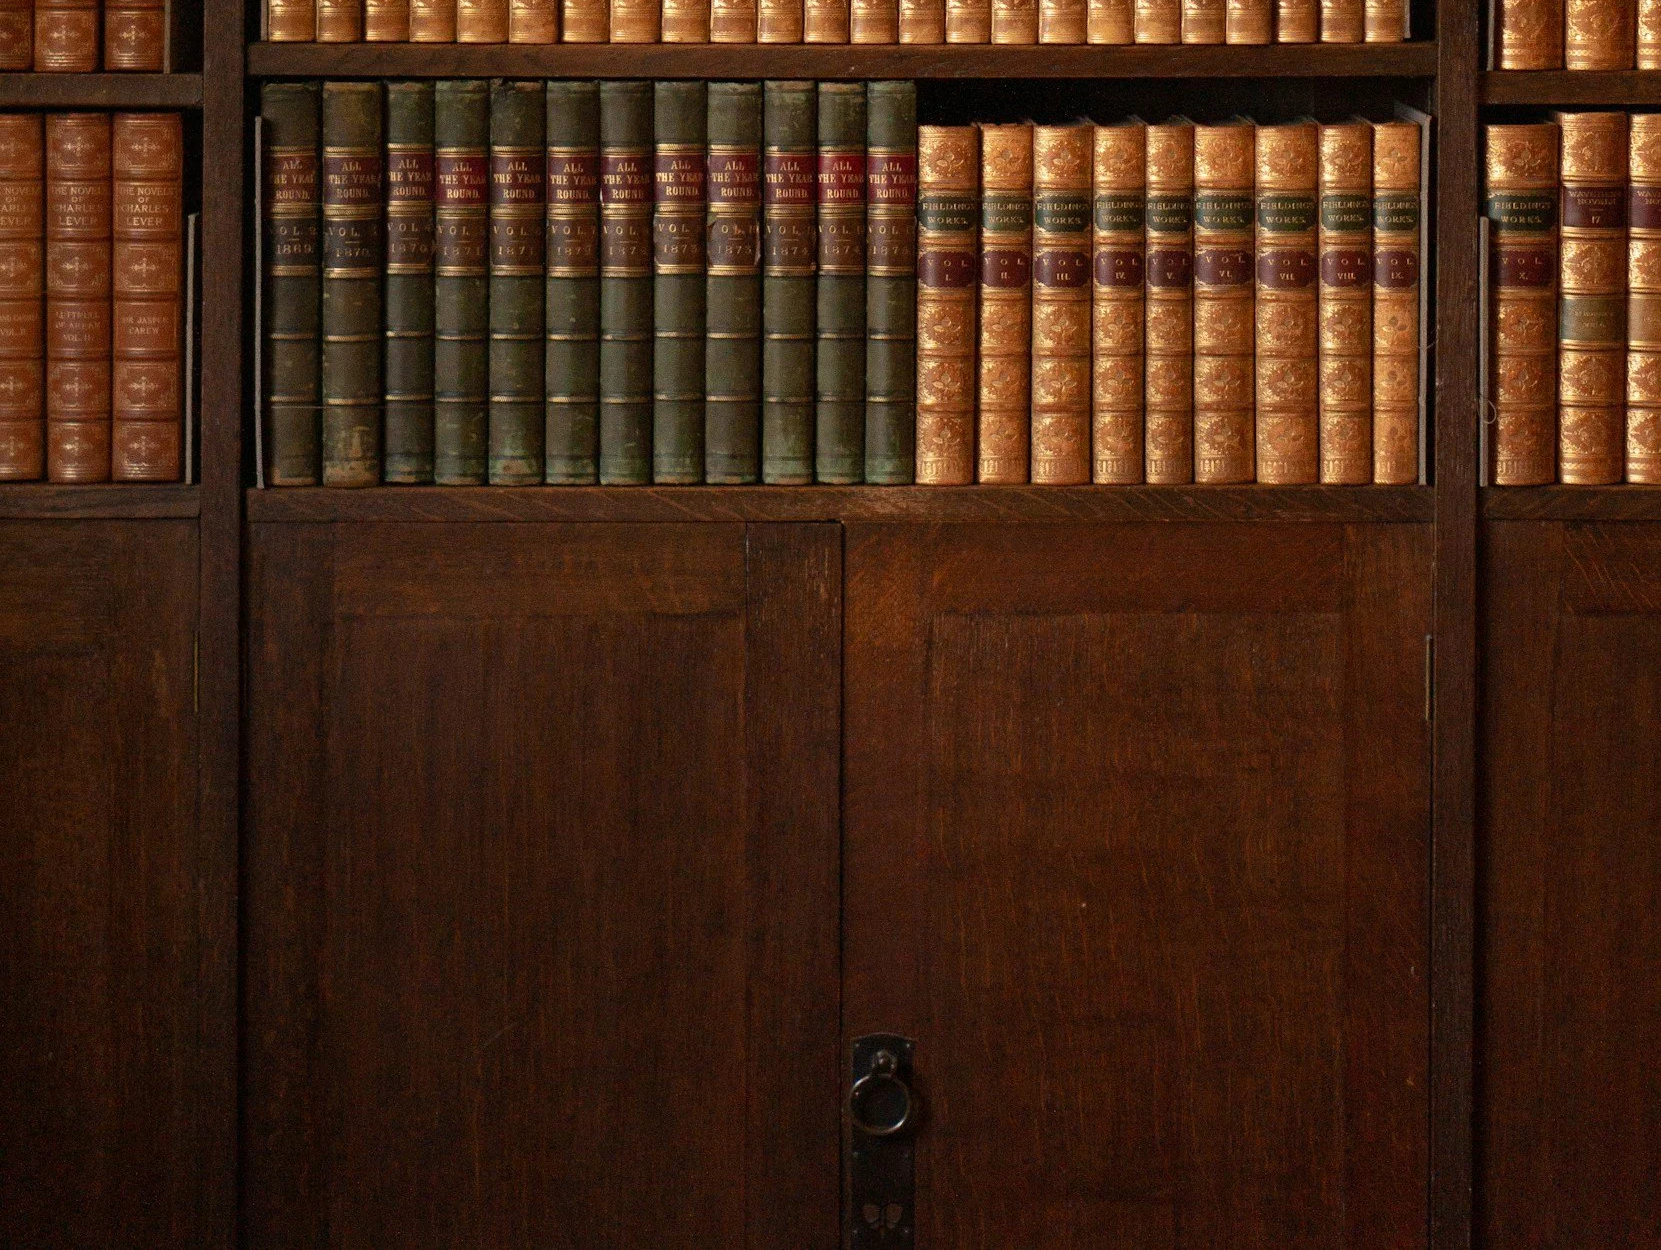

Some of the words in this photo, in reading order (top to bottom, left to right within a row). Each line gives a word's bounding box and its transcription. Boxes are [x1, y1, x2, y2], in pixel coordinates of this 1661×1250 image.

[341, 161, 362, 171] ALL
[452, 162, 472, 172] ALL
[508, 162, 528, 171] ALL
[670, 160, 691, 170] ALL
[724, 161, 745, 171] ALL
[832, 161, 853, 171] ALL
[881, 161, 902, 171] ALL
[328, 175, 347, 184] THE
[439, 175, 458, 185] THE
[493, 173, 512, 183] THE
[655, 172, 674, 182] THE
[712, 172, 730, 182] THE
[818, 173, 836, 182] THE
[869, 174, 887, 184] THE
[53, 204, 103, 213] CHARLES
[120, 204, 169, 213] CHARLES
[58, 217, 99, 226] LEVER
[126, 217, 163, 226] LEVER
